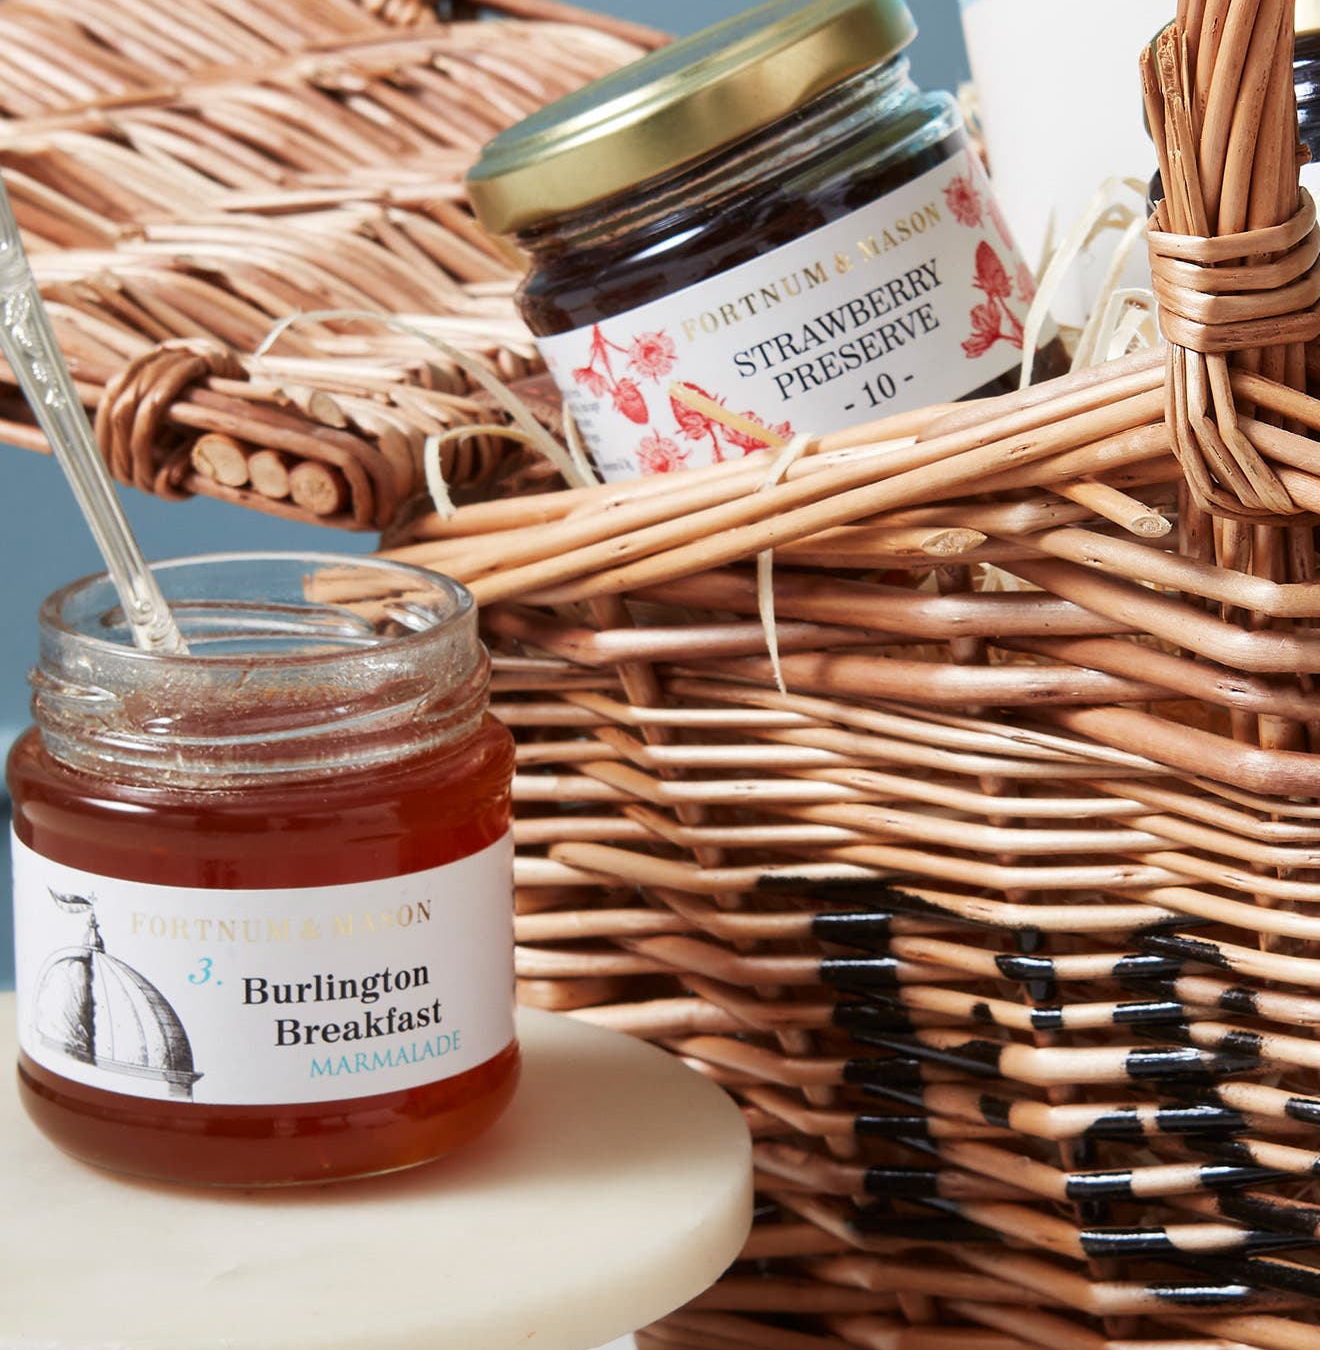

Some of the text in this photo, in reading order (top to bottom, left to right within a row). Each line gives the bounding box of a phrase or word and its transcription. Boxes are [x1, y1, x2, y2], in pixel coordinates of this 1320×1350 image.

[680, 203, 942, 343] FORTNUM & MASON
[733, 258, 943, 378] STRAWBERRY
[773, 303, 940, 401] PRESERVE
[130, 899, 432, 943] FORTNUM & MASON
[188, 957, 223, 986] 3.
[241, 965, 430, 1006] Burlington
[274, 998, 443, 1047] Breakfast
[309, 1029, 462, 1079] MARMALADE
